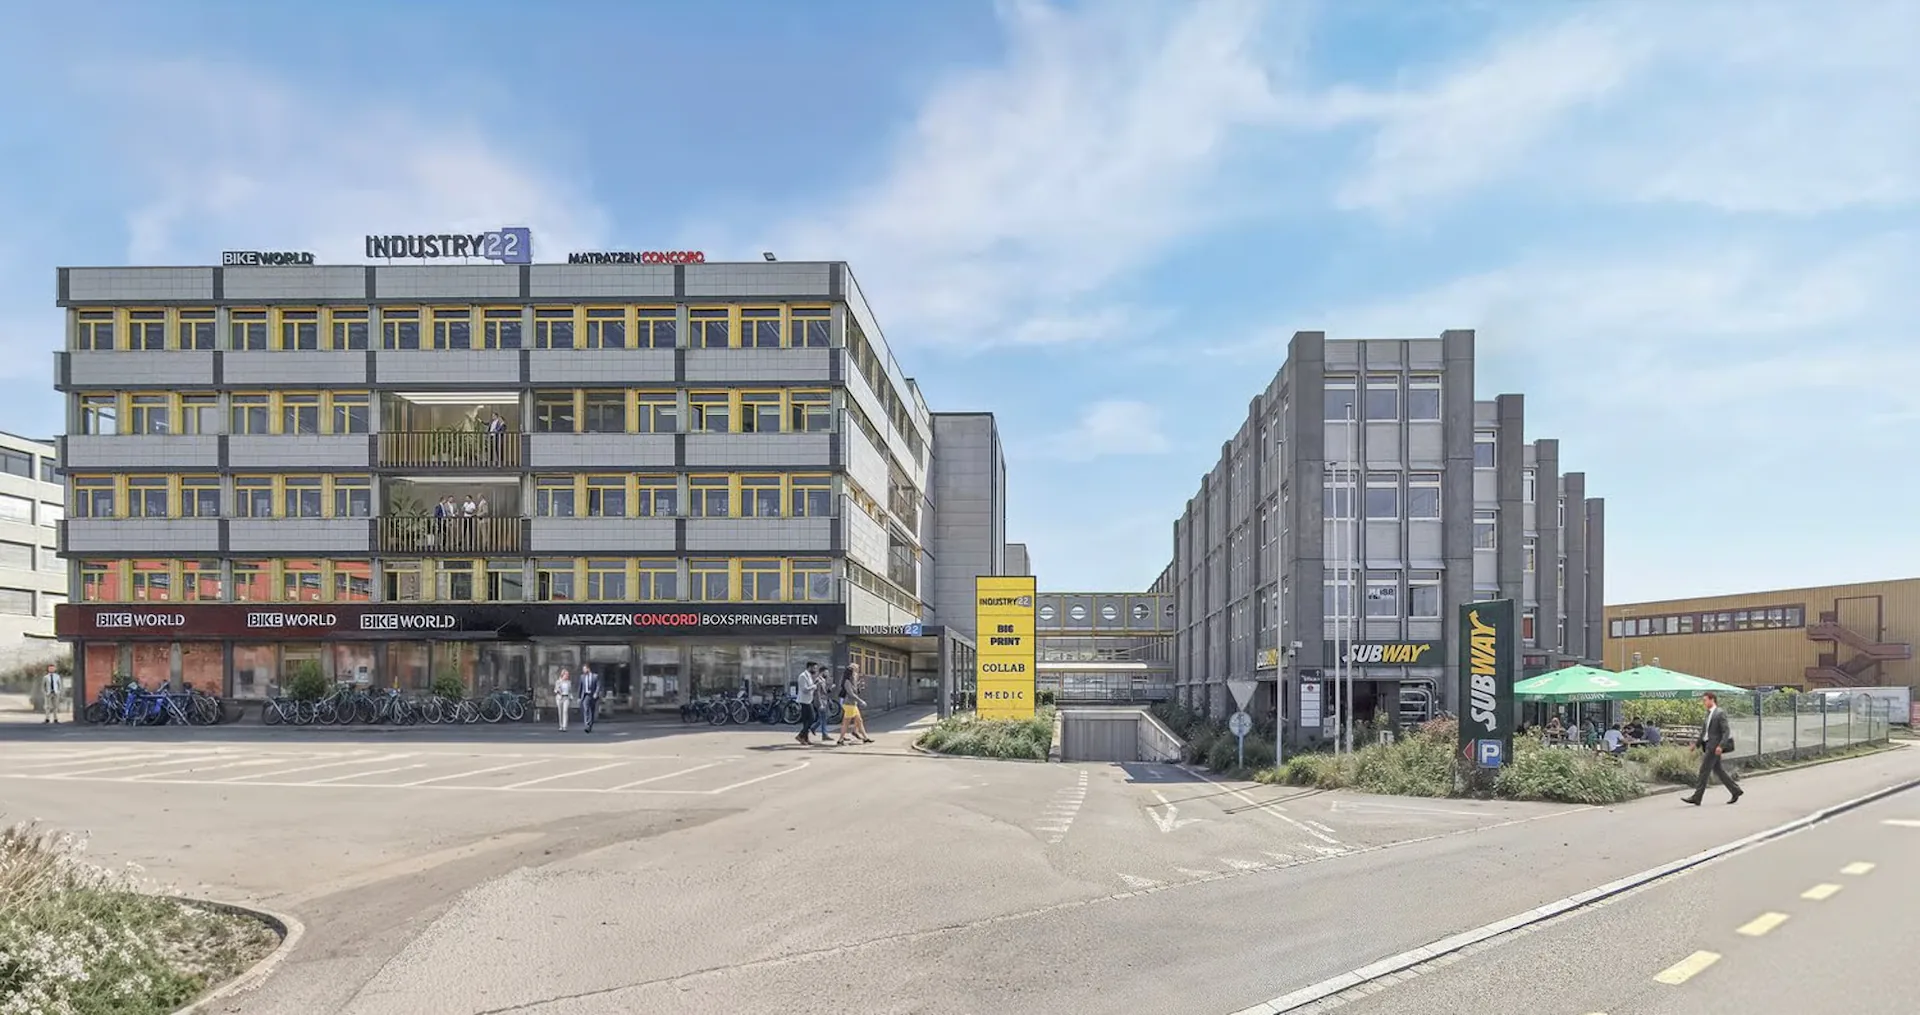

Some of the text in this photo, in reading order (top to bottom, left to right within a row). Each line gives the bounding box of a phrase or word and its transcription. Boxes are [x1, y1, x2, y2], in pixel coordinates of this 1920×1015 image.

[557, 613, 818, 626] MATRATZEN CONCORD BOXSPRINGBETTEN
[997, 624, 1014, 633] BIG
[990, 637, 1020, 646] PRINT
[1342, 644, 1430, 662] SUBWAY
[983, 663, 1025, 673] COLLAB
[1469, 609, 1497, 732] SUBWAY
[984, 691, 1023, 699] MEDIC
[1482, 743, 1500, 764] P
